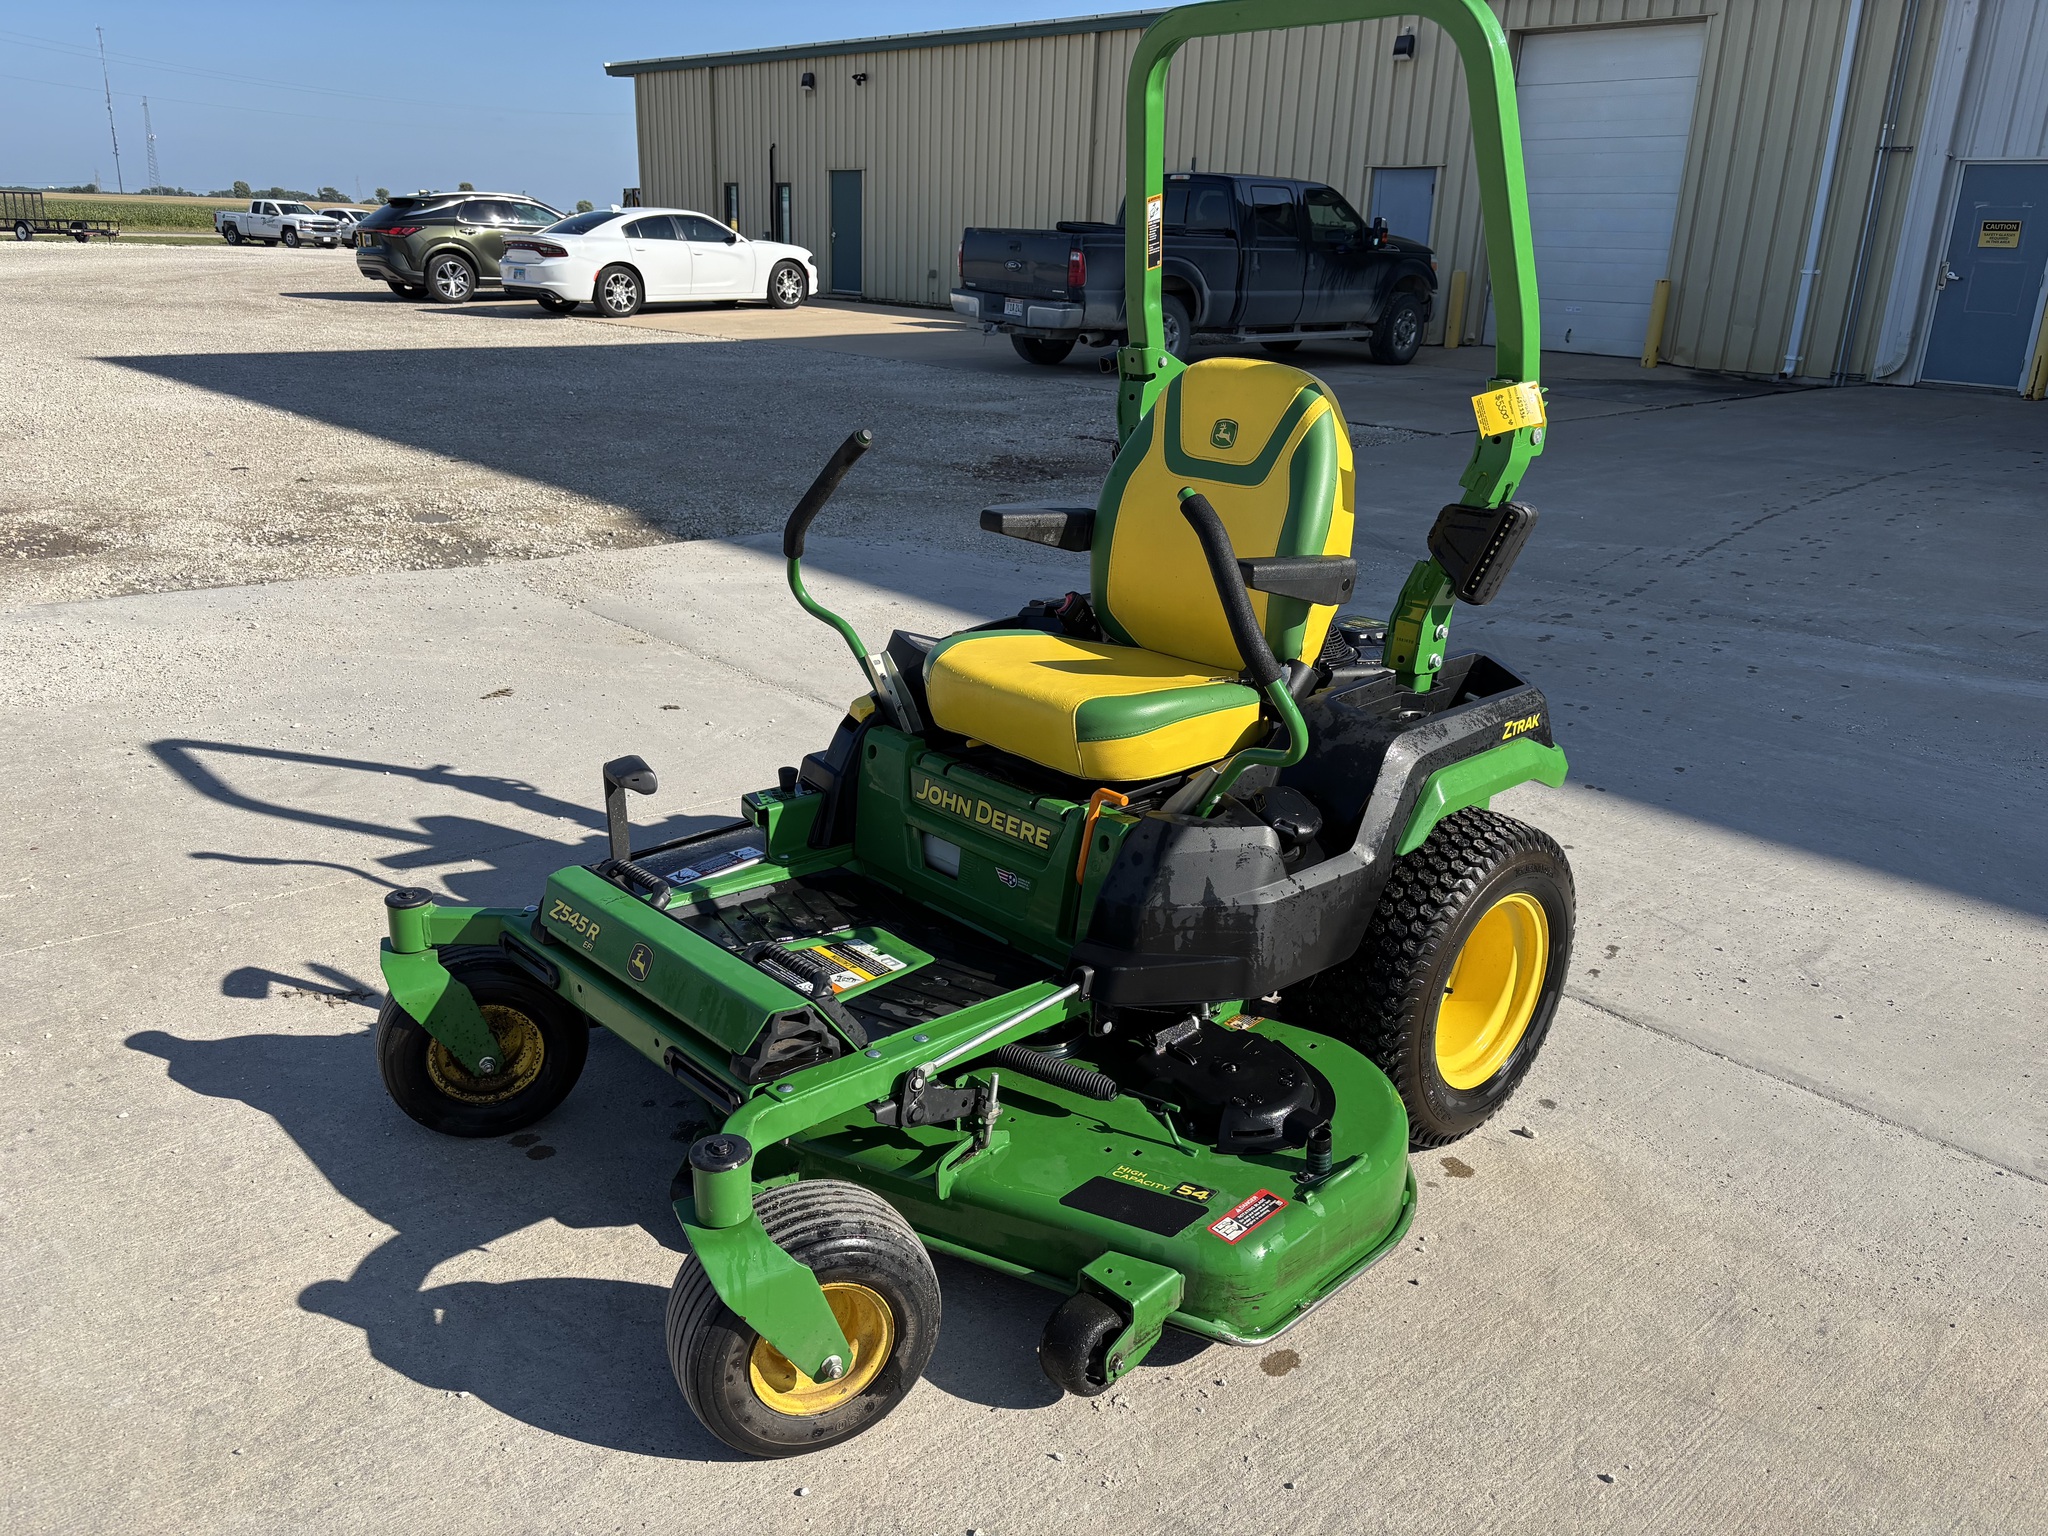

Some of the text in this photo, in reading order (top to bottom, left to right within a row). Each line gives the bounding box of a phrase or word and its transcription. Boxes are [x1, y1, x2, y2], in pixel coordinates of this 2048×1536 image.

[1501, 712, 1541, 740] ZTRAK
[915, 777, 1052, 850] JOHN DEERE
[582, 940, 594, 952] EFI
[1116, 1164, 1149, 1178] HIGH
[1111, 1170, 1171, 1192] CAPACITY
[1176, 1184, 1210, 1200] 54
[1238, 1195, 1259, 1210] DANGER
